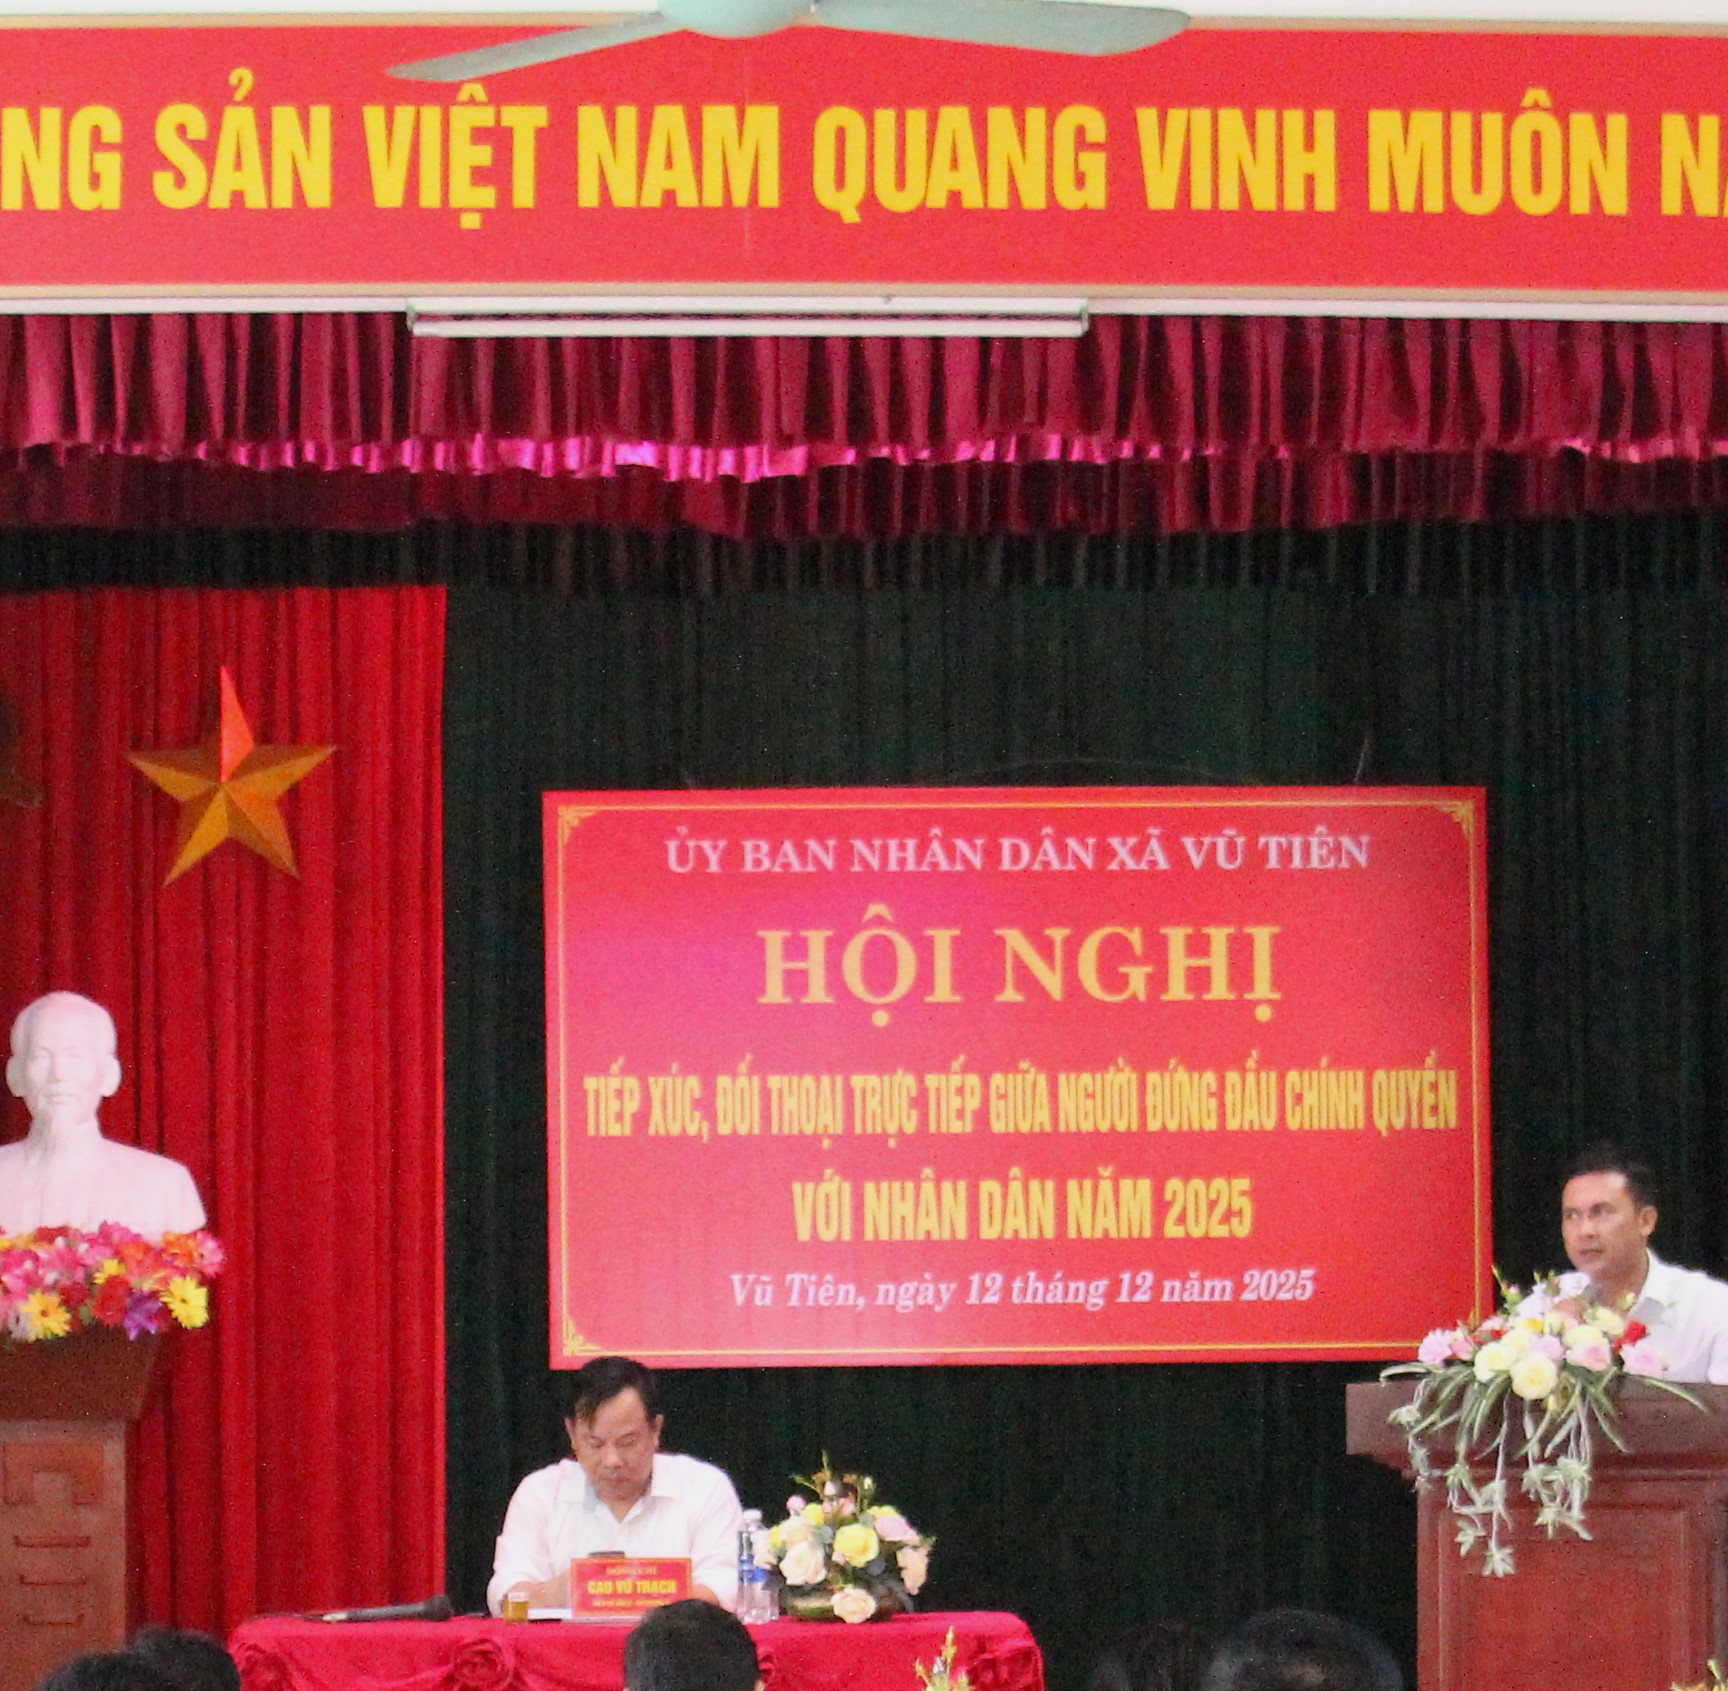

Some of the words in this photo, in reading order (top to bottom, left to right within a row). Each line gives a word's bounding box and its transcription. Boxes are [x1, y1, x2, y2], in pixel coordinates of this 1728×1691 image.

[153, 68, 332, 209] SẢN
[363, 83, 548, 229] VIỆT
[578, 105, 779, 207] NAM
[813, 105, 1107, 223] QUANG
[1136, 107, 1336, 211] VINH
[1369, 88, 1628, 215] MUÔN
[665, 826, 727, 873] ỦY
[741, 839, 837, 872] BAN
[850, 827, 985, 872] NHÂN
[999, 826, 1096, 871] DÂN
[1107, 827, 1170, 870] XÃ
[1181, 830, 1246, 870] VŨ
[1258, 825, 1369, 869] TIÊN
[757, 903, 962, 1028] HỘI
[995, 926, 1281, 1022] NGHỊ
[583, 1057, 641, 1136] TIẾP
[648, 1063, 710, 1142] XÚC,
[715, 1054, 761, 1135] ĐỐI
[767, 1074, 844, 1148] THOẠI
[850, 1068, 918, 1148] TRỰC
[924, 1054, 983, 1133] TIẾP
[989, 1061, 1052, 1133] GIỮA
[1058, 1057, 1139, 1132] NGƯỜI
[1145, 1059, 1218, 1132] ĐỨNG
[1224, 1050, 1278, 1130] ĐẦU
[1285, 1057, 1365, 1130] CHÍNH
[1372, 1051, 1457, 1136] QUYỀN
[792, 1168, 852, 1242] VỚI
[864, 1168, 968, 1241] NHÂN
[979, 1167, 1055, 1239] DÂN
[1067, 1166, 1152, 1238] NĂM
[1164, 1177, 1252, 1238] 2025
[731, 1274, 774, 1307] Vũ
[785, 1272, 867, 1311] Tiên,
[873, 1273, 957, 1314] ngày
[966, 1272, 1003, 1304] 12
[1011, 1271, 1110, 1311] tháng
[1116, 1271, 1154, 1302] 12
[1161, 1271, 1234, 1302] năm
[1240, 1268, 1315, 1300] 2025
[587, 1580, 613, 1595] CAO
